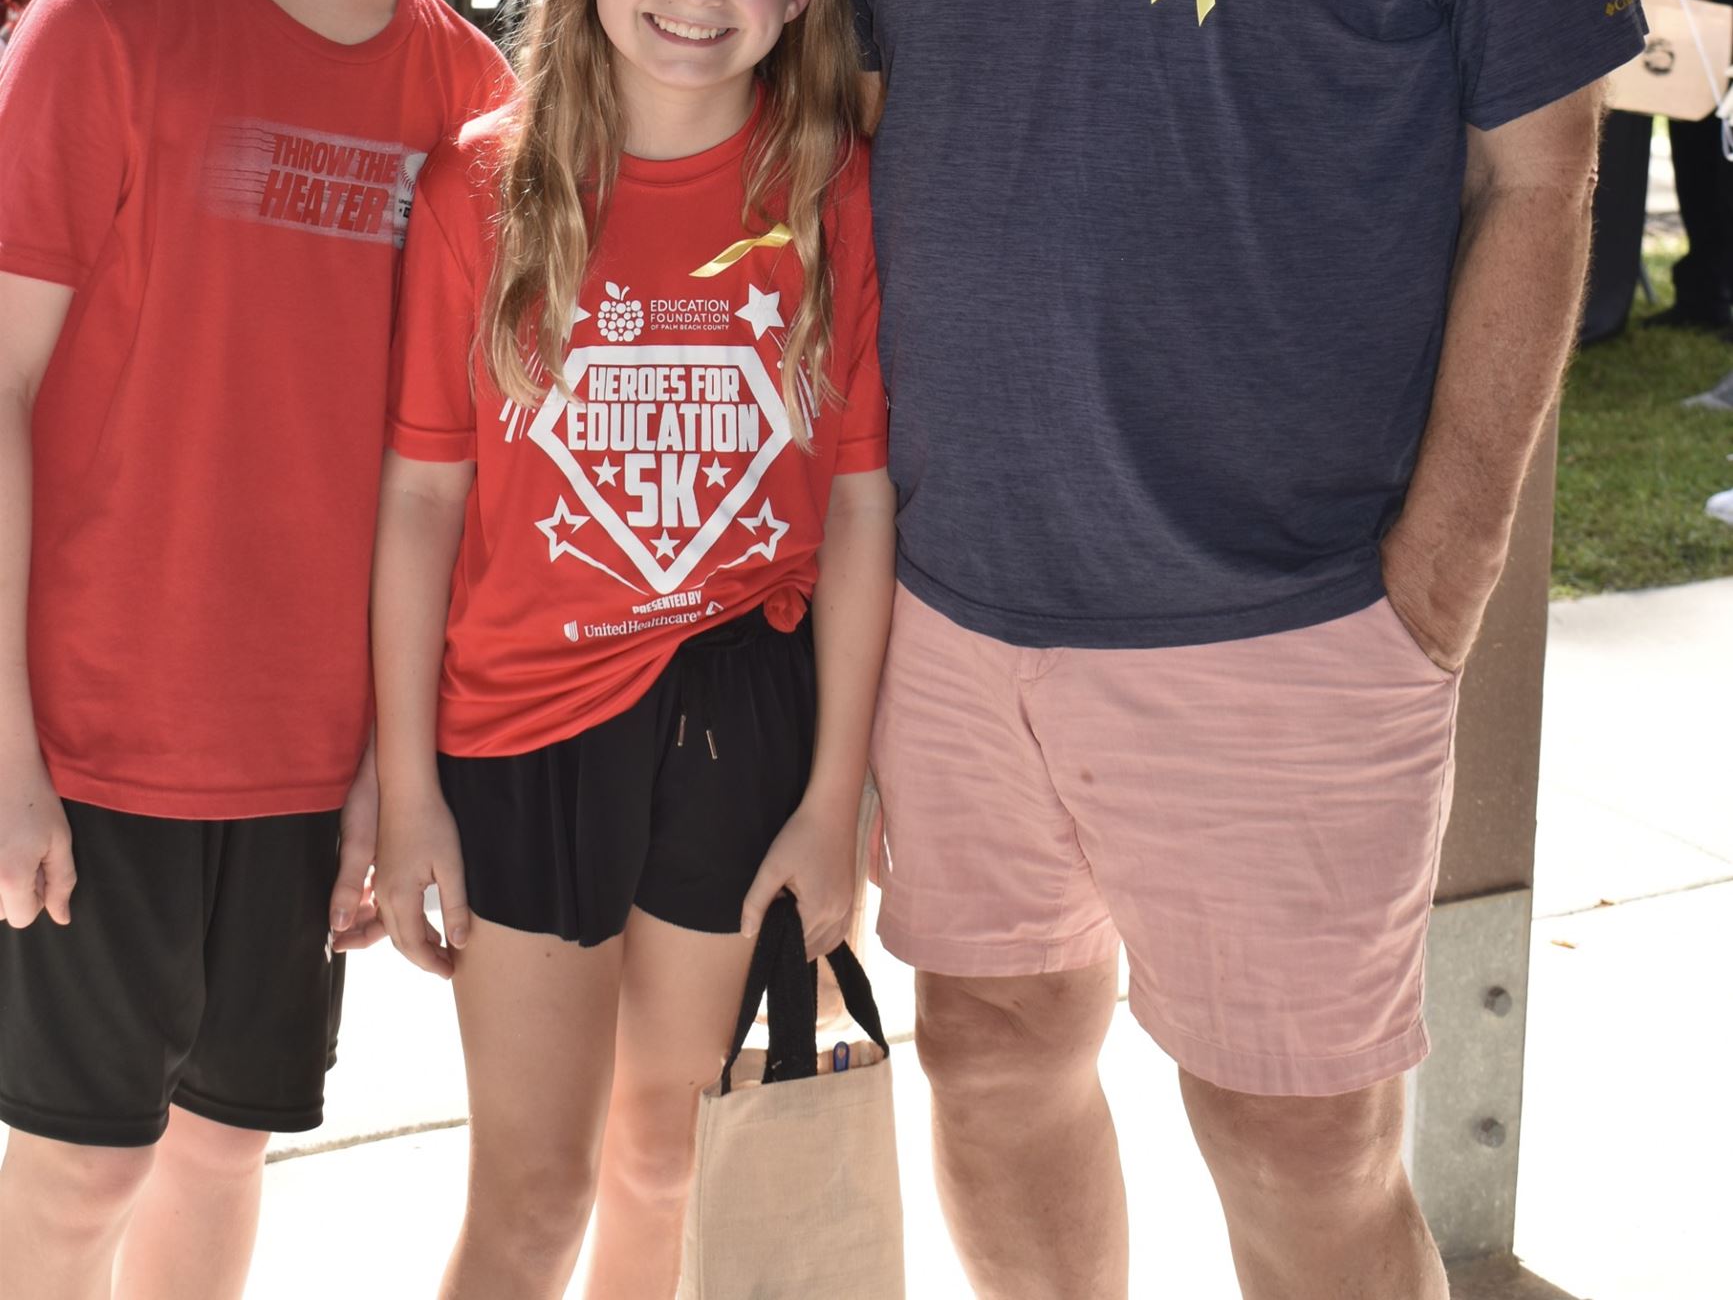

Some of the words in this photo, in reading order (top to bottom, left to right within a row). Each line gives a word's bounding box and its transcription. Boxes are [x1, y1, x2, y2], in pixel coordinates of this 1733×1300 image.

[273, 133, 354, 176] THROW
[353, 149, 400, 183] THE
[258, 168, 390, 234] HEATER
[650, 299, 730, 312] EDUCATION
[650, 313, 730, 323] FOUNDATION
[588, 366, 686, 402] HEROES
[691, 367, 740, 402] FOR
[567, 403, 759, 452] EDUCATION
[624, 453, 701, 528] 5K
[632, 592, 688, 614] PRESENTED
[688, 589, 702, 605] BY
